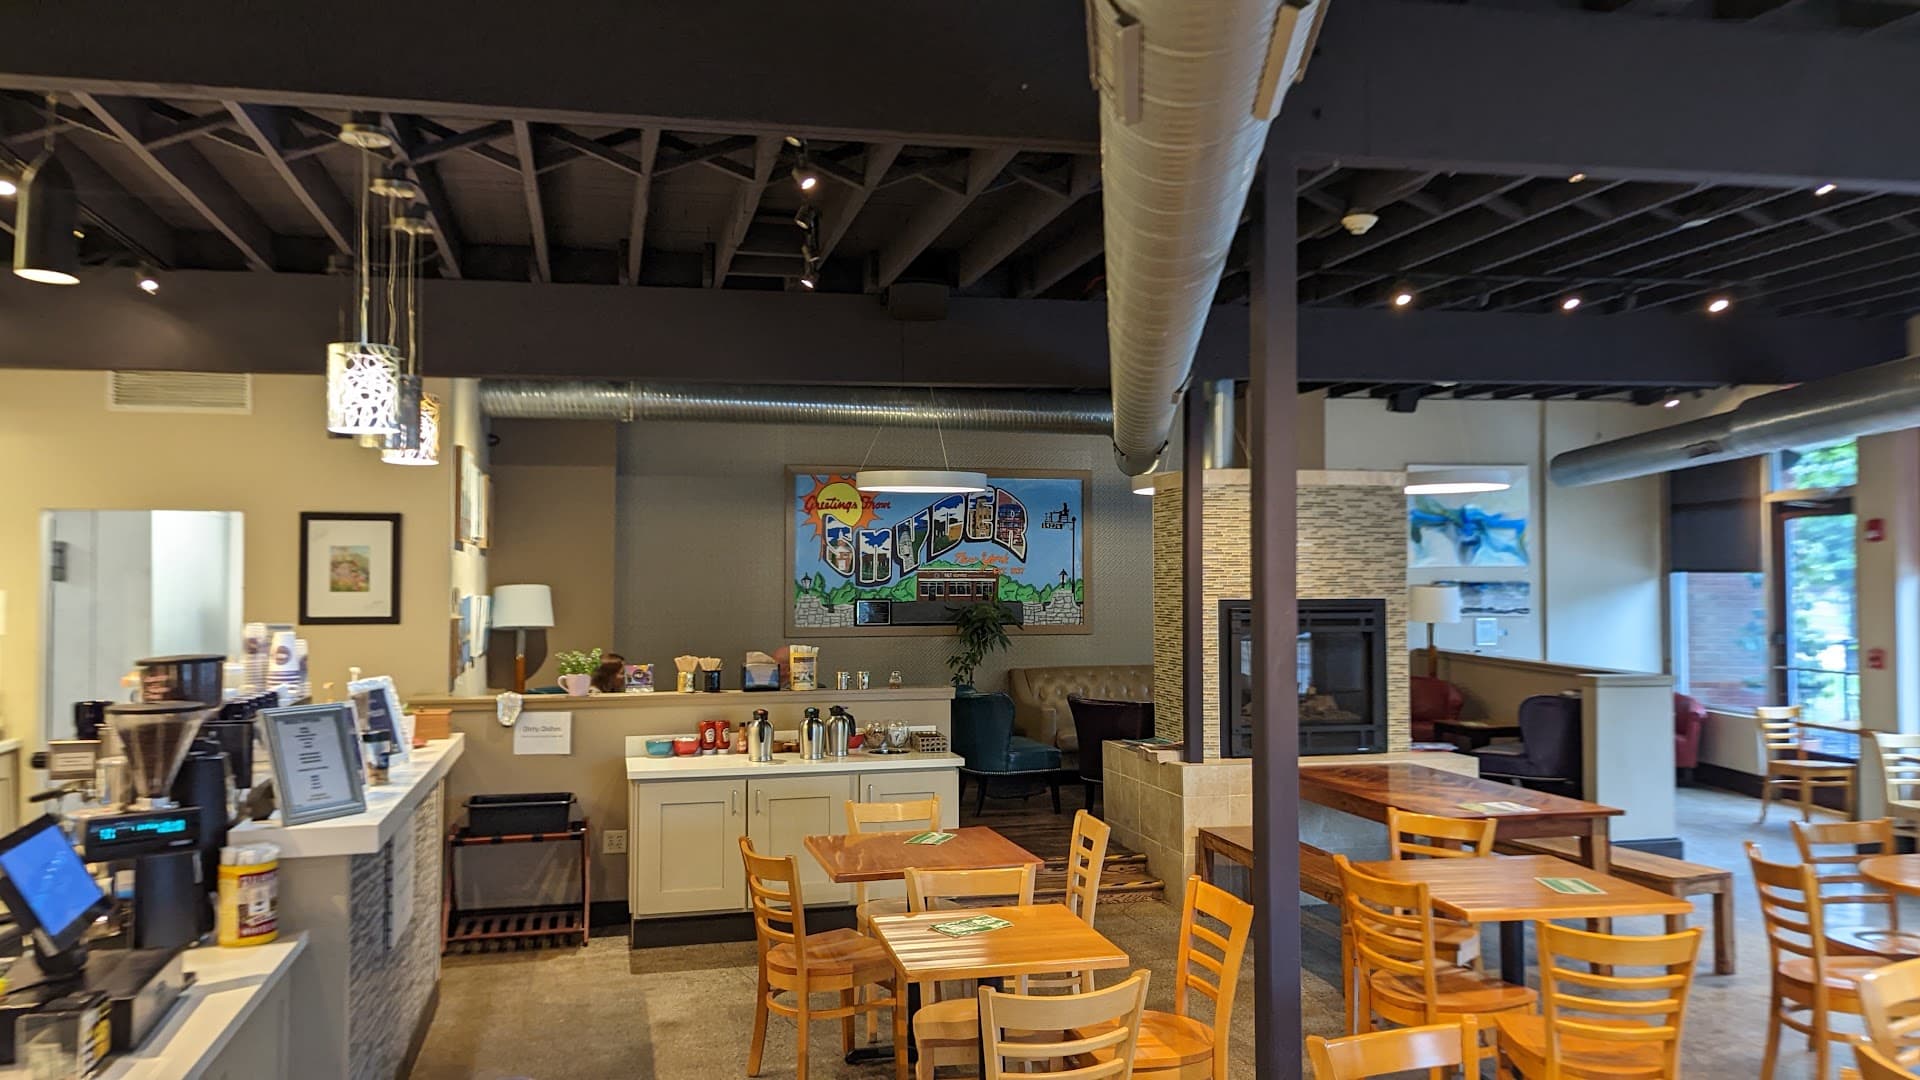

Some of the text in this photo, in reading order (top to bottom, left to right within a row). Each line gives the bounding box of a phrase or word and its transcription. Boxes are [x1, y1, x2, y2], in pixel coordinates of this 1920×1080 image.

[804, 496, 891, 514] Greetings From
[981, 551, 1009, 571] York
